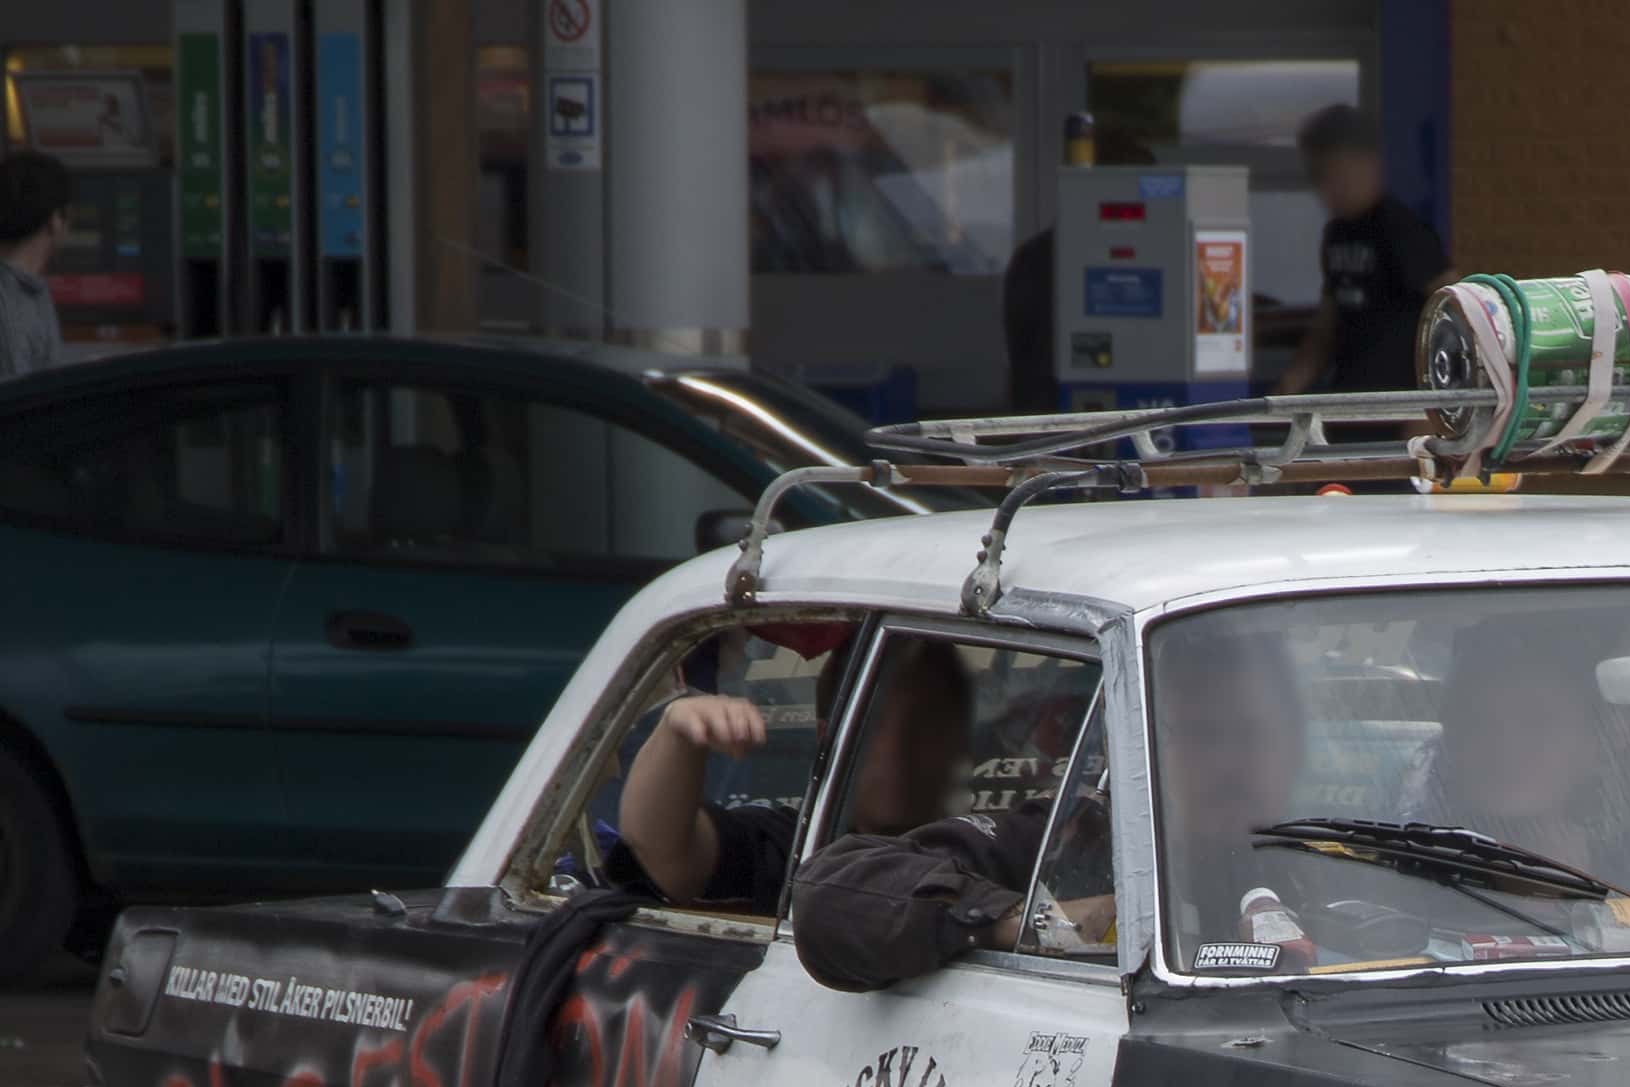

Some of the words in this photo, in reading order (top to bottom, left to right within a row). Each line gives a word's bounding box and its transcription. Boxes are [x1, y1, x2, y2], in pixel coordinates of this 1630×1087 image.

[1200, 945, 1275, 959] FORNMINNE
[165, 966, 217, 1002] KILLAR
[216, 973, 249, 1007] MED
[248, 978, 281, 1013] STIL
[280, 976, 323, 1019] ÅKER
[320, 988, 413, 1032] PILSNERBIL!
